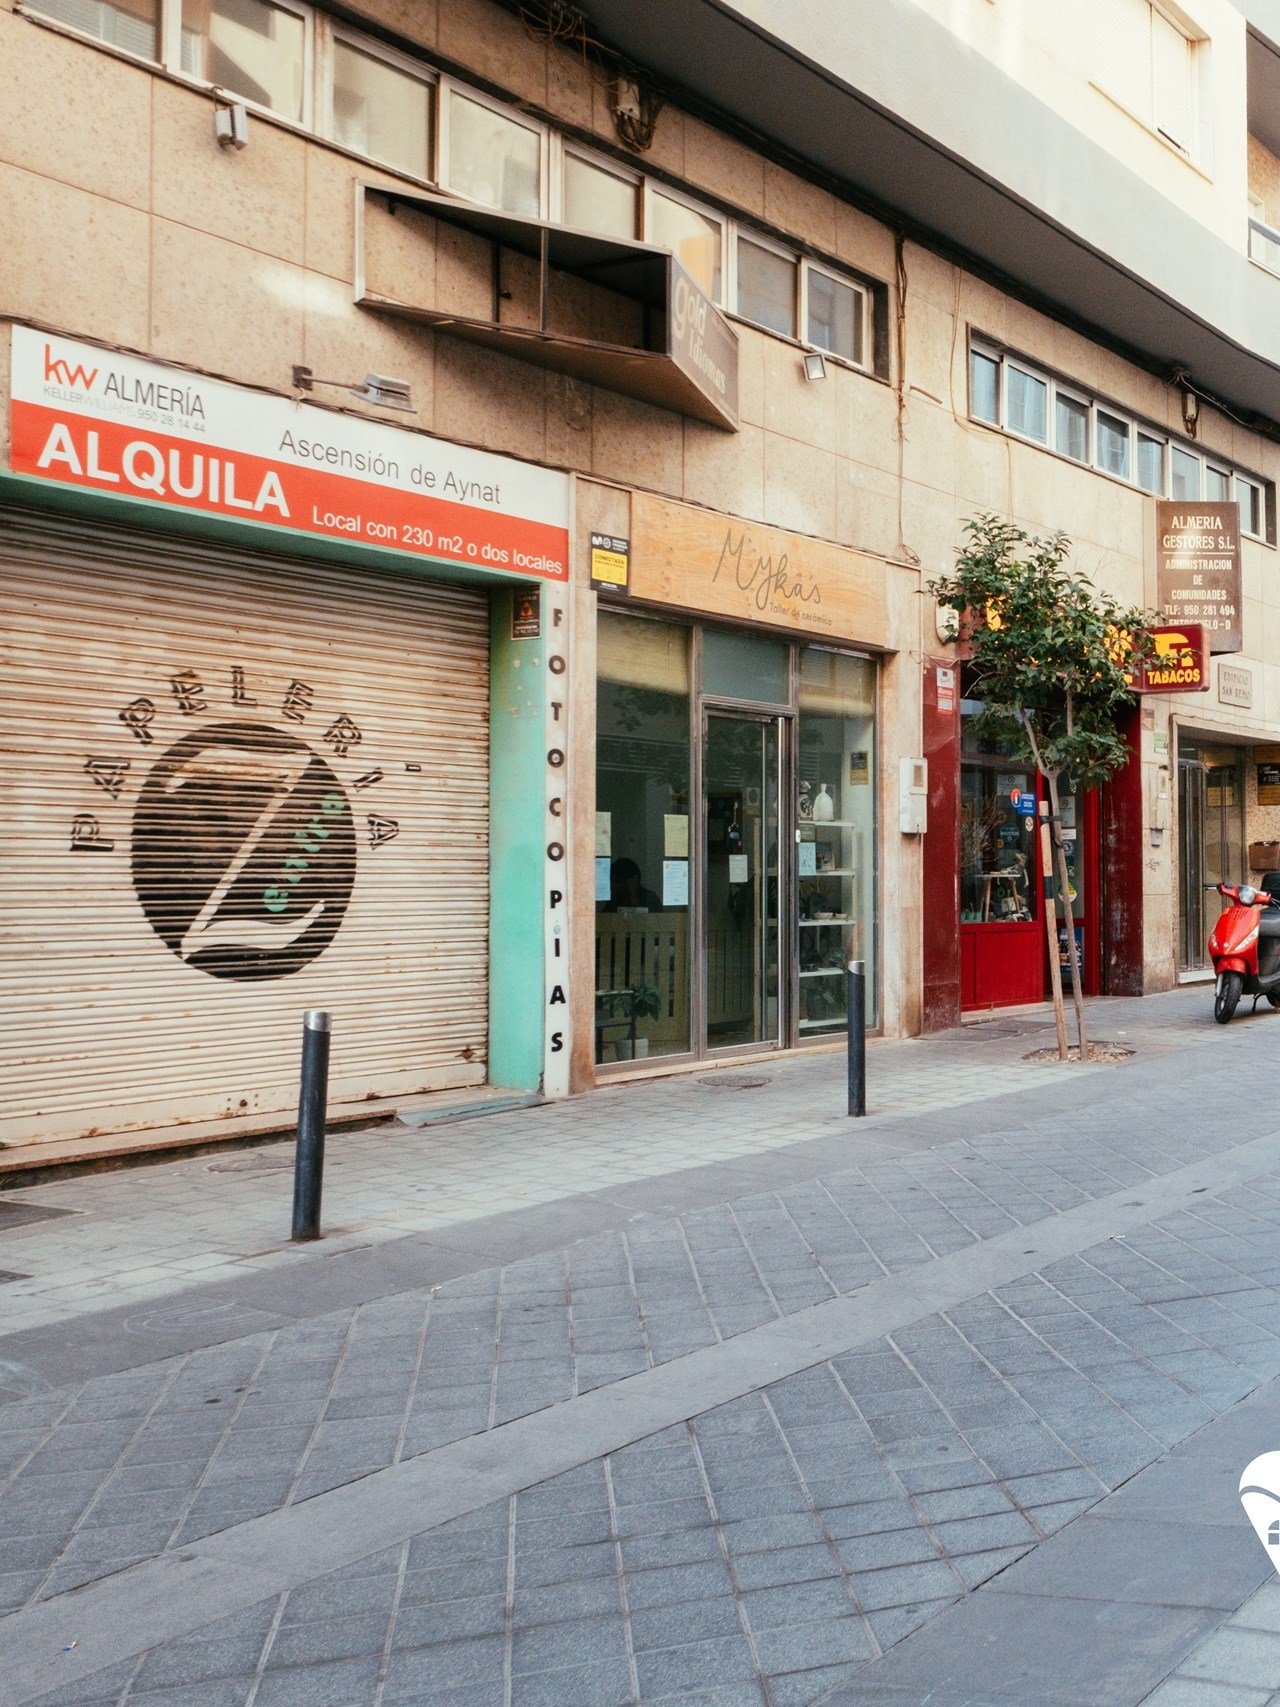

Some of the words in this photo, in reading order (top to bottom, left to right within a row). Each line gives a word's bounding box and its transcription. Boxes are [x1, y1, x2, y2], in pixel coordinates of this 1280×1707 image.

[673, 276, 707, 340] gold
[104, 372, 206, 420] ALMERÍA
[138, 410, 157, 422] 950
[161, 415, 173, 426] 28
[179, 419, 189, 429] 14
[193, 422, 206, 432] 44
[37, 423, 291, 517] ALQUILA
[279, 430, 400, 480] Ascensión
[411, 464, 436, 490] de
[443, 470, 501, 505] Aynat
[1172, 516, 1222, 530] ALMERIA
[312, 506, 361, 533] Local
[367, 522, 397, 538] con
[403, 525, 432, 548] 230
[438, 533, 462, 553] m2
[467, 543, 477, 556] o
[481, 541, 508, 562] dos
[513, 548, 562, 574] locales
[1163, 534, 1214, 549] GESTORES
[1218, 536, 1235, 549] S.L.
[1165, 559, 1232, 570] ADMINISTRACION
[1193, 575, 1203, 585] DE
[1171, 589, 1227, 600] COMUNIDADES
[769, 601, 790, 616] Taller
[791, 607, 801, 618] de
[1164, 605, 1181, 615] TLF:
[1184, 605, 1199, 616] 950
[1203, 605, 1217, 616] 281
[1220, 605, 1235, 616] 494
[1147, 668, 1201, 685] TABACOS
[547, 608, 567, 1052] FOTOCOPIAS
